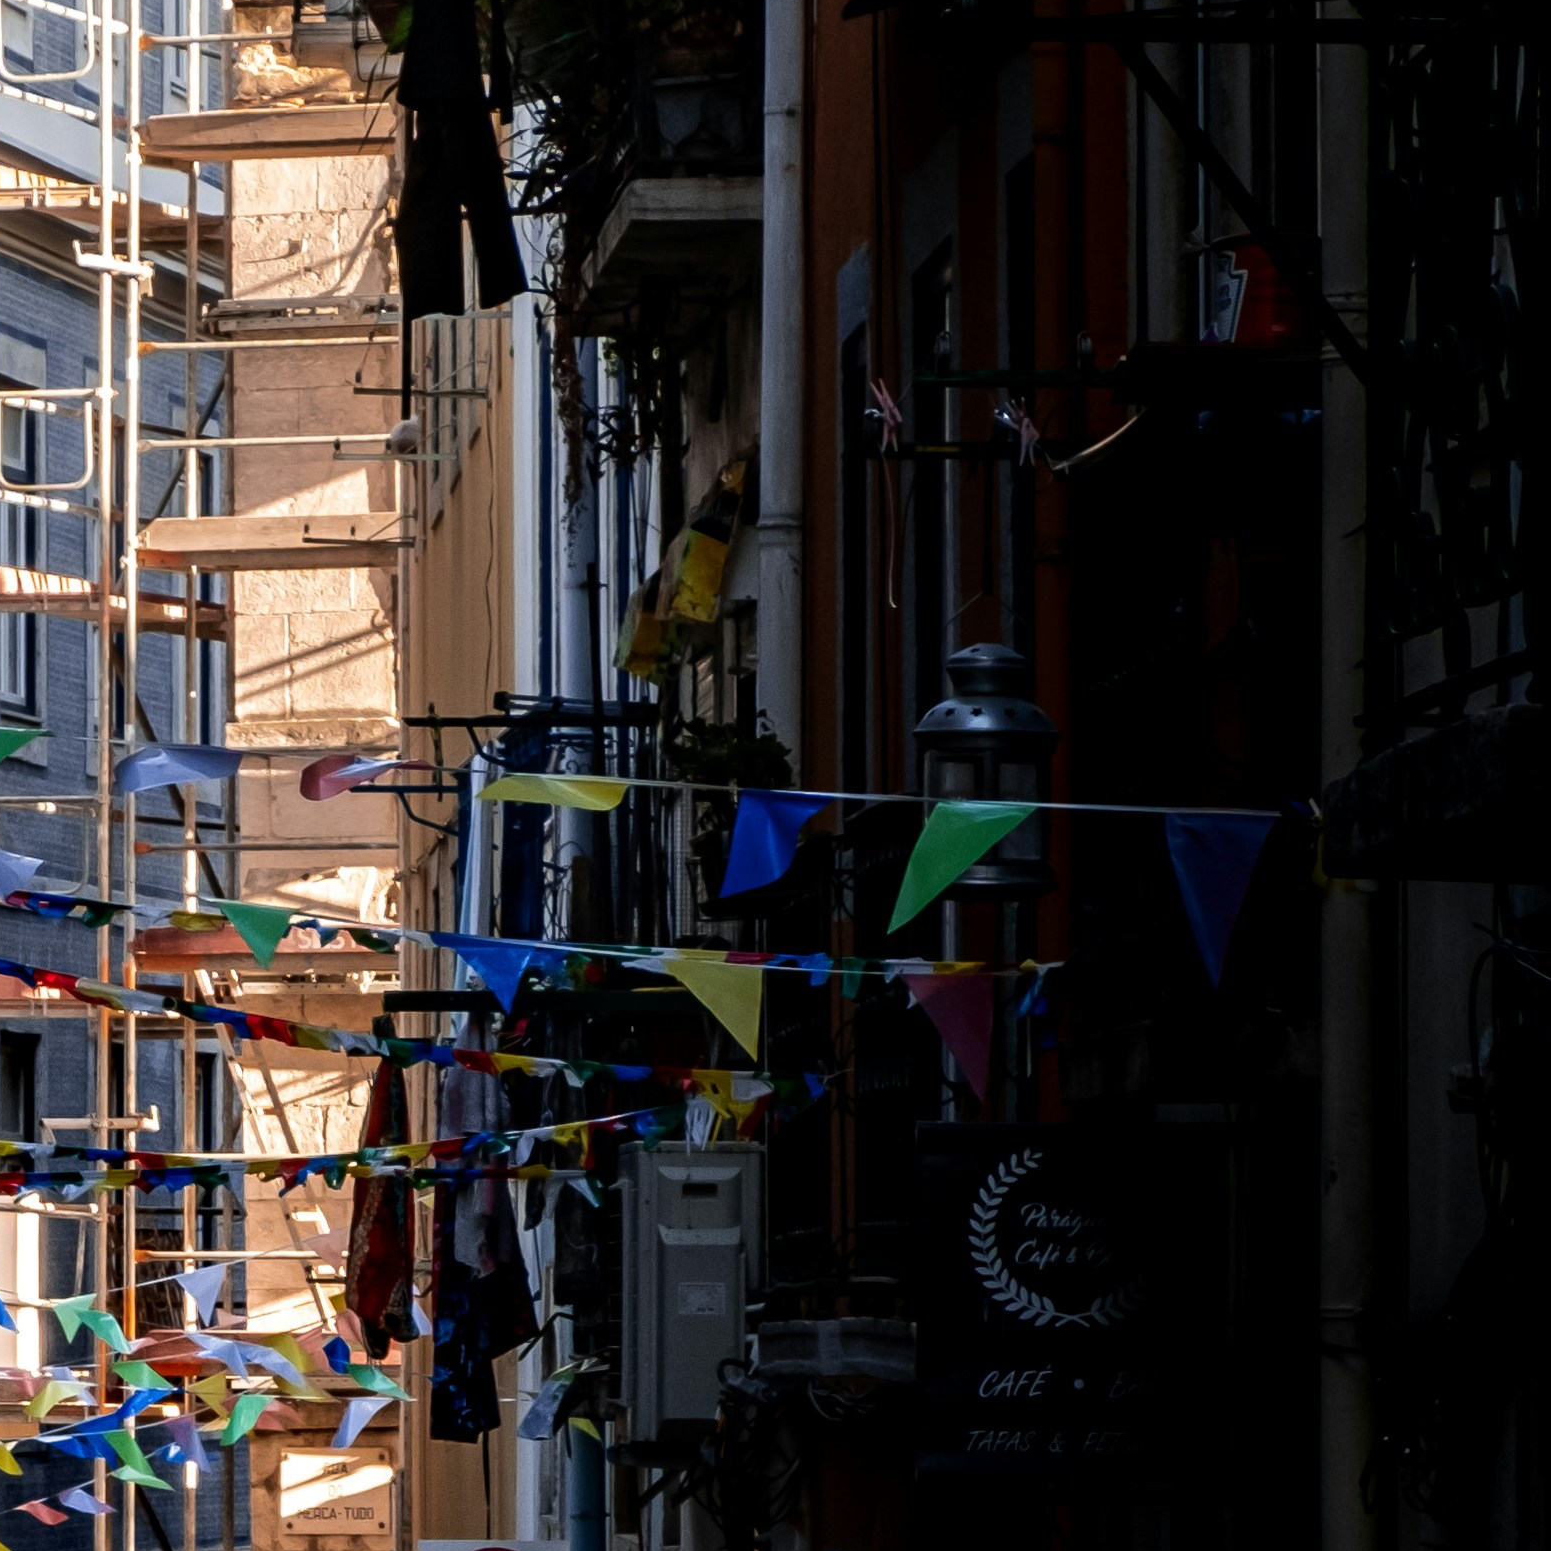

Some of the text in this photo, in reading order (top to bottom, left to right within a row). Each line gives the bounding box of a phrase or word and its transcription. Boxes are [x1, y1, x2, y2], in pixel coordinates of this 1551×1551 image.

[978, 1364, 1054, 1399] CAFÉ
[966, 1429, 1037, 1453] TAPAS
[1047, 1431, 1067, 1453] &
